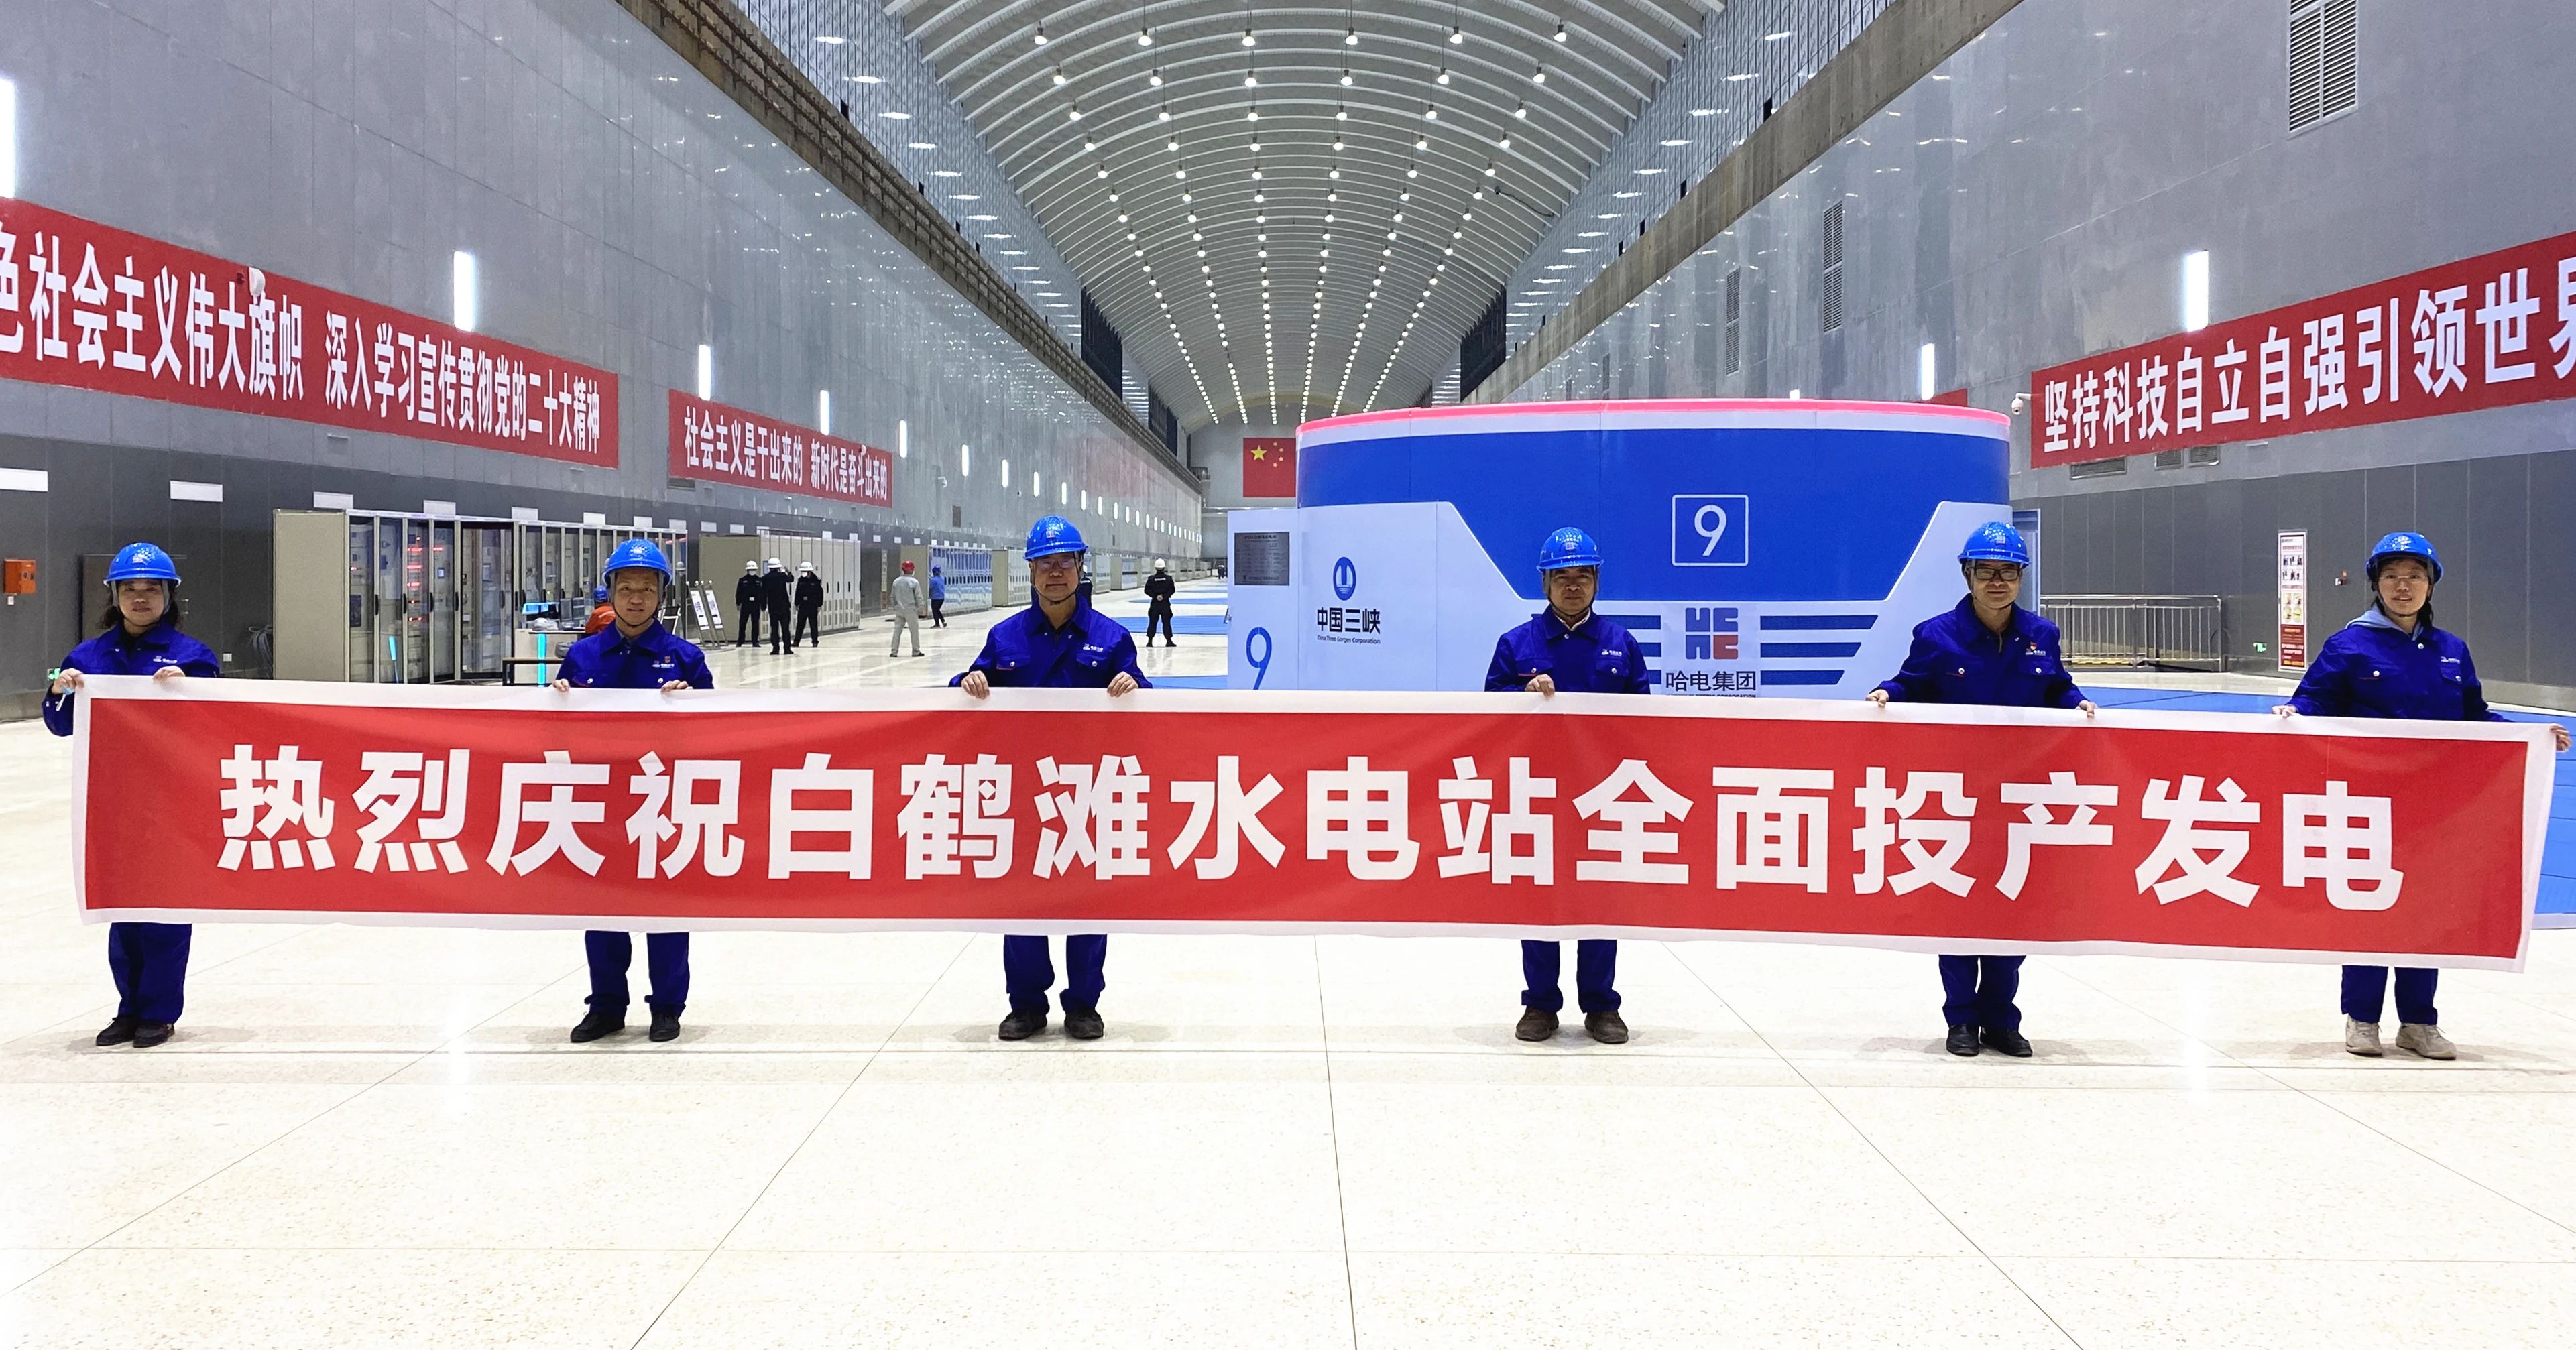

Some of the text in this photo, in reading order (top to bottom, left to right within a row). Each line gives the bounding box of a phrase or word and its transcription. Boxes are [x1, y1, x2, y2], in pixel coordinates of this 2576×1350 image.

[0, 223, 600, 454] 色社会主义伟大旗帜 深入学习宣传贯彻党的二十大精神
[684, 406, 887, 500] 社会主义是干出来的 新时代是奋斗出来的
[1694, 505, 1726, 556] 9
[1318, 607, 1381, 634] 中国三峡
[1337, 636, 1351, 644] Gorges
[1246, 627, 1272, 690] 9
[1666, 670, 1757, 692] 哈电集团
[217, 744, 2404, 910] 热烈庆祝白鹤滩水电站全面投产发电
